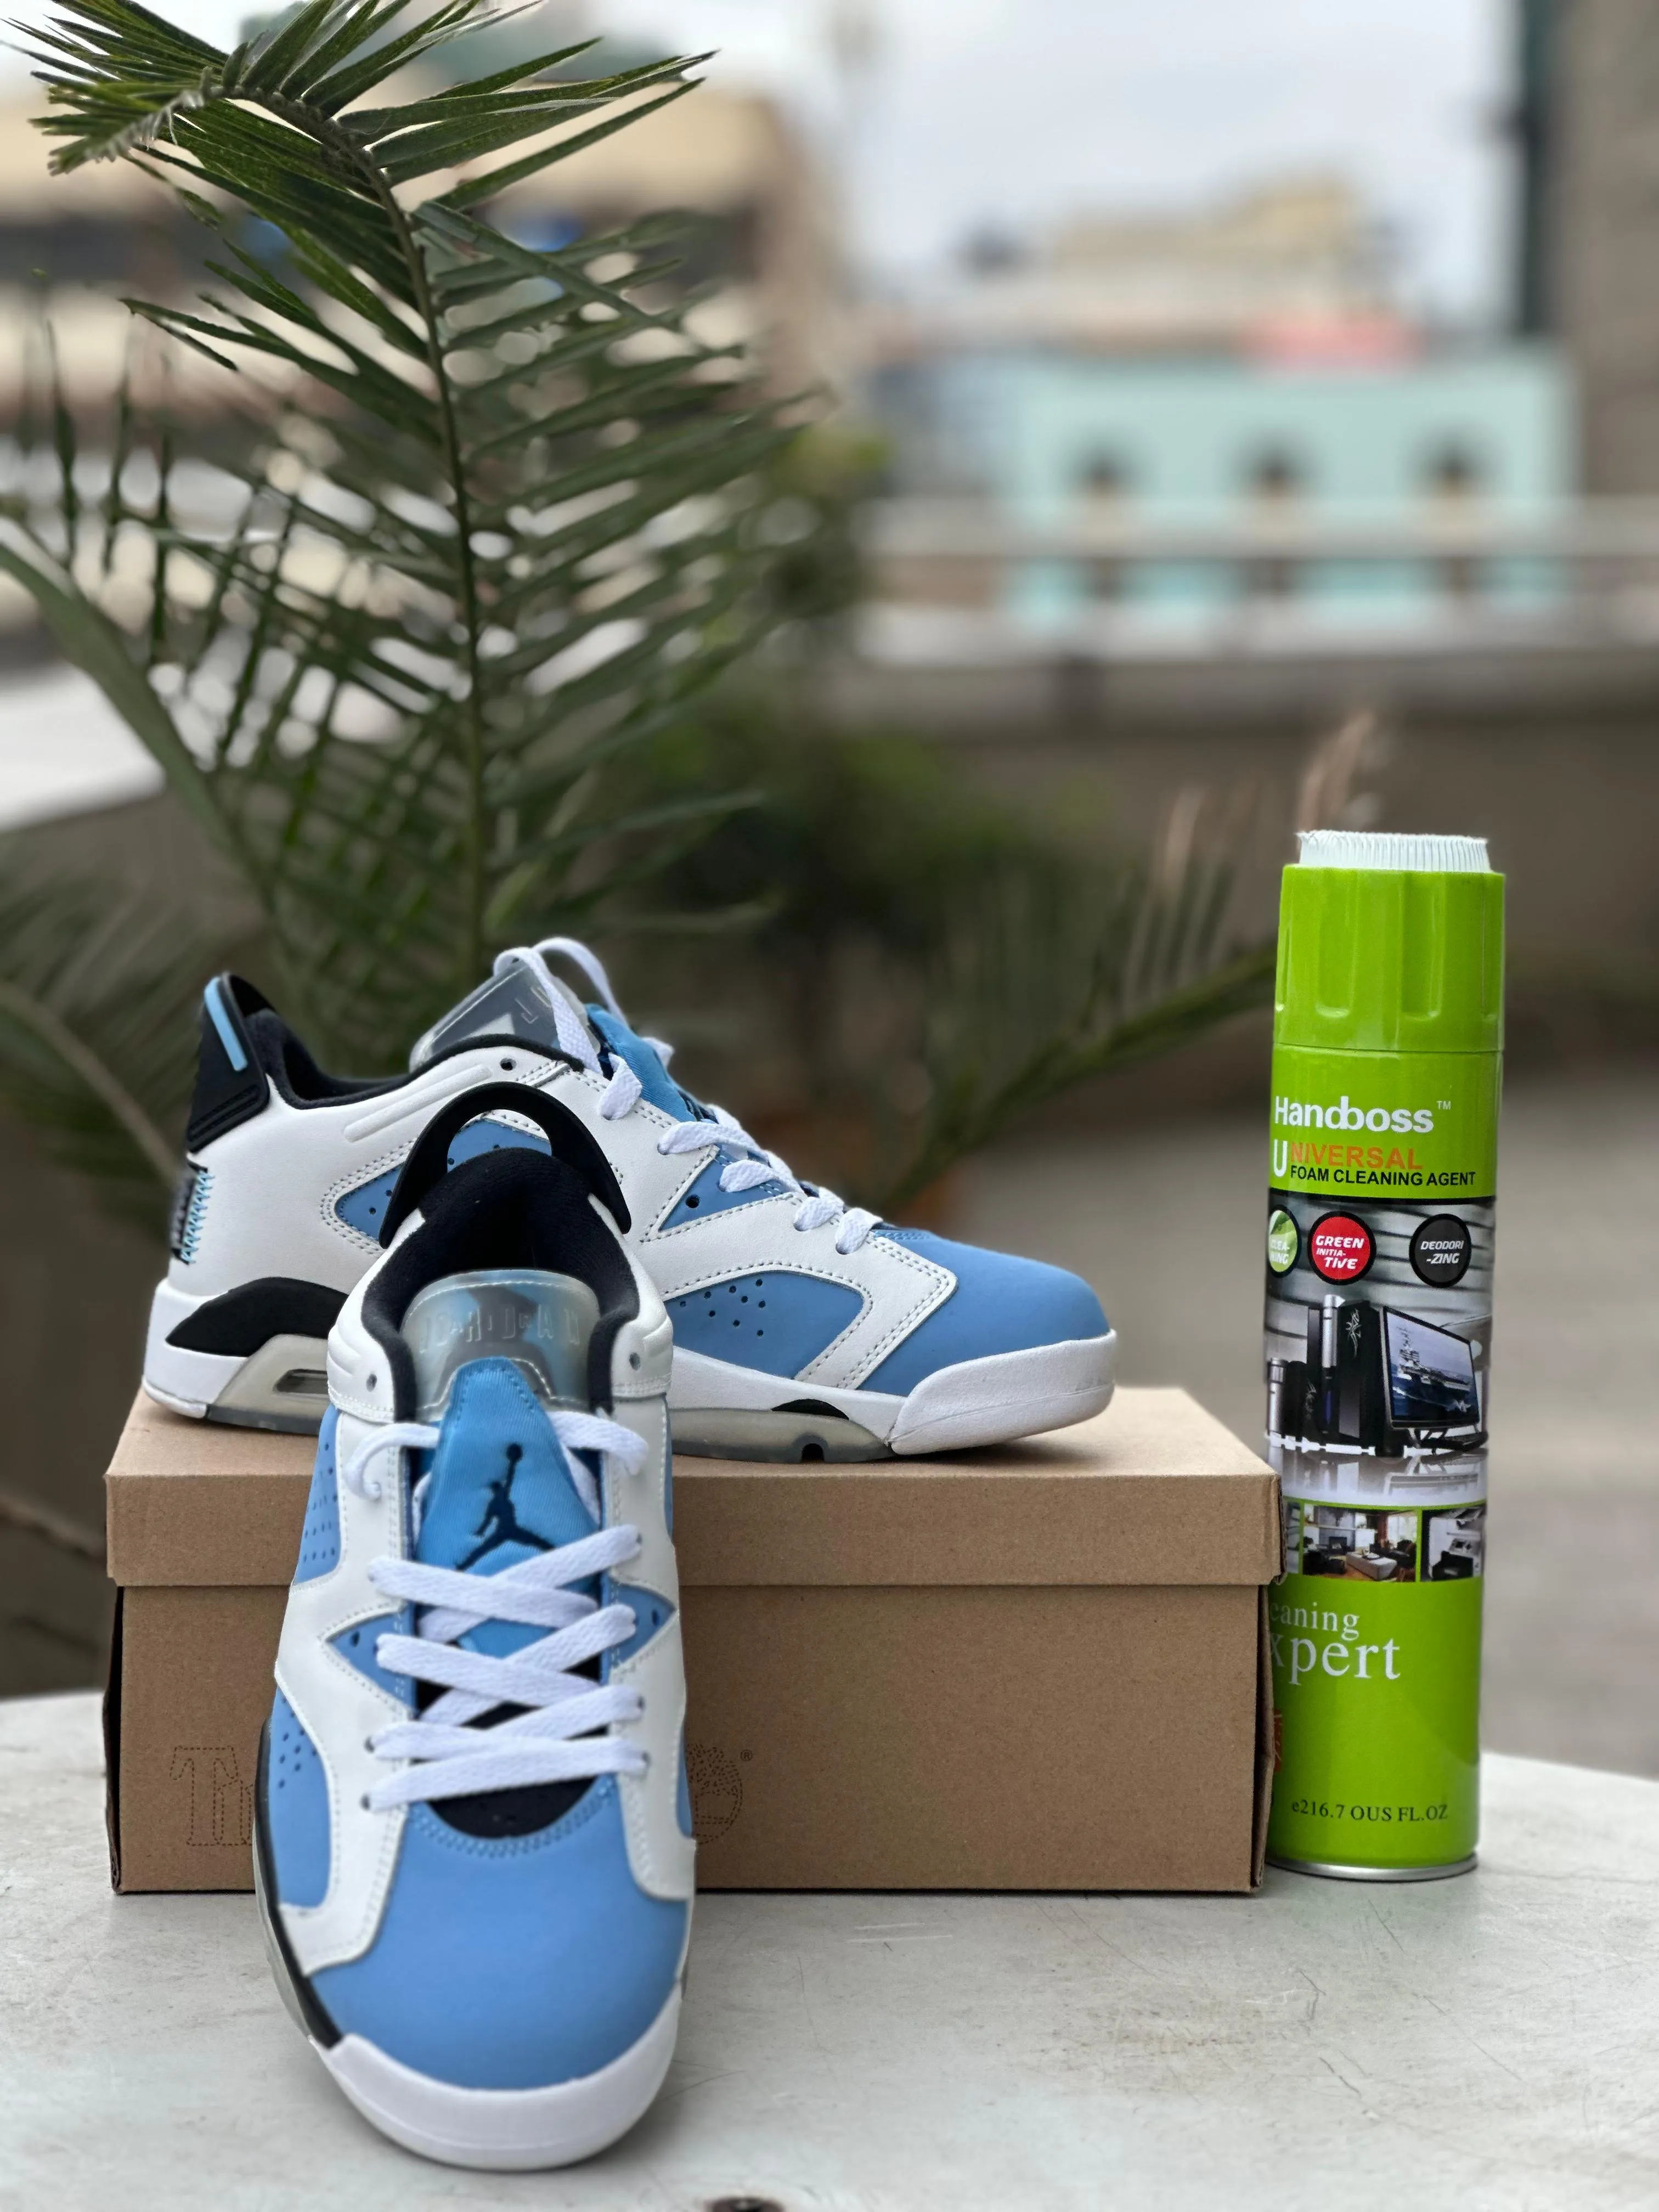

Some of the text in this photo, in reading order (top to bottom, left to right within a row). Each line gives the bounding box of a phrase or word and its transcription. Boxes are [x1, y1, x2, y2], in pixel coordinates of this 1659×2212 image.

[1274, 1096, 1434, 1133] Handboss
[1272, 1138, 1423, 1177] UNIVERSAL
[1290, 1164, 1476, 1186] FOAM CLEANING AGENT
[1316, 1235, 1364, 1249] GREEN
[1316, 1248, 1346, 1257] INITIA-
[1420, 1240, 1464, 1250] DEODORI
[1324, 1256, 1358, 1269] TIVE
[1269, 1601, 1359, 1641] eaning
[1270, 1632, 1400, 1686] xpert
